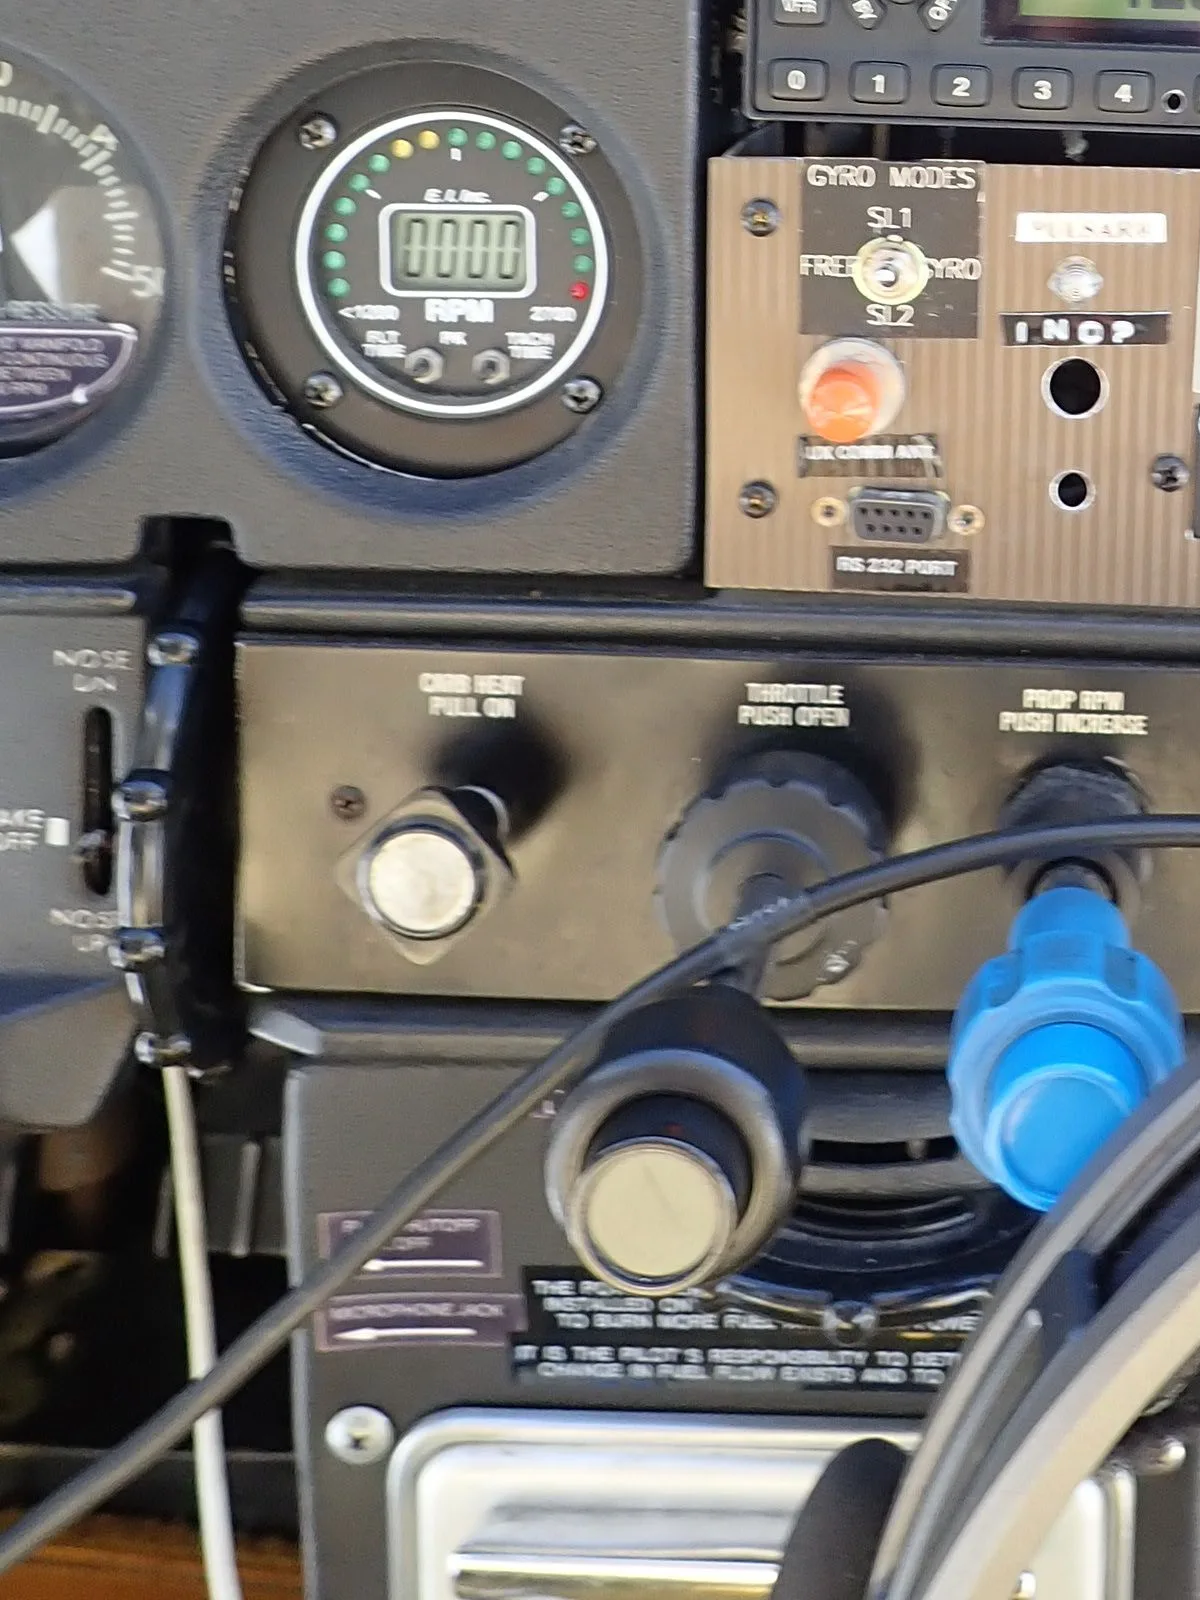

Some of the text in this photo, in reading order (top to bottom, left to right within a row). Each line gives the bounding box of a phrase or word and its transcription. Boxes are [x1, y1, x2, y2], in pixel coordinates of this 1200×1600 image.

[787, 70, 805, 88] 0
[871, 75, 885, 93] 1
[952, 77, 970, 96] 2
[1034, 81, 1052, 99] 3
[1115, 85, 1133, 102] 4
[807, 166, 976, 189] GYRO MODES
[867, 207, 912, 229] SL1
[424, 299, 494, 323] RPM
[866, 305, 915, 327] SL2
[837, 556, 959, 575] RS 232 PORT
[53, 650, 132, 670] NOSE
[1079, 691, 1124, 711] RPM
[737, 705, 850, 727] PUSH OPEN
[999, 711, 1054, 732] PUSH
[555, 1313, 590, 1328] TO
[656, 1314, 719, 1329] MORE
[537, 1363, 624, 1377] CHANGE
[656, 1364, 711, 1379] FUEL
[712, 1365, 777, 1380] FLOW
[861, 1368, 908, 1383] AND
[910, 1369, 945, 1384] TO
